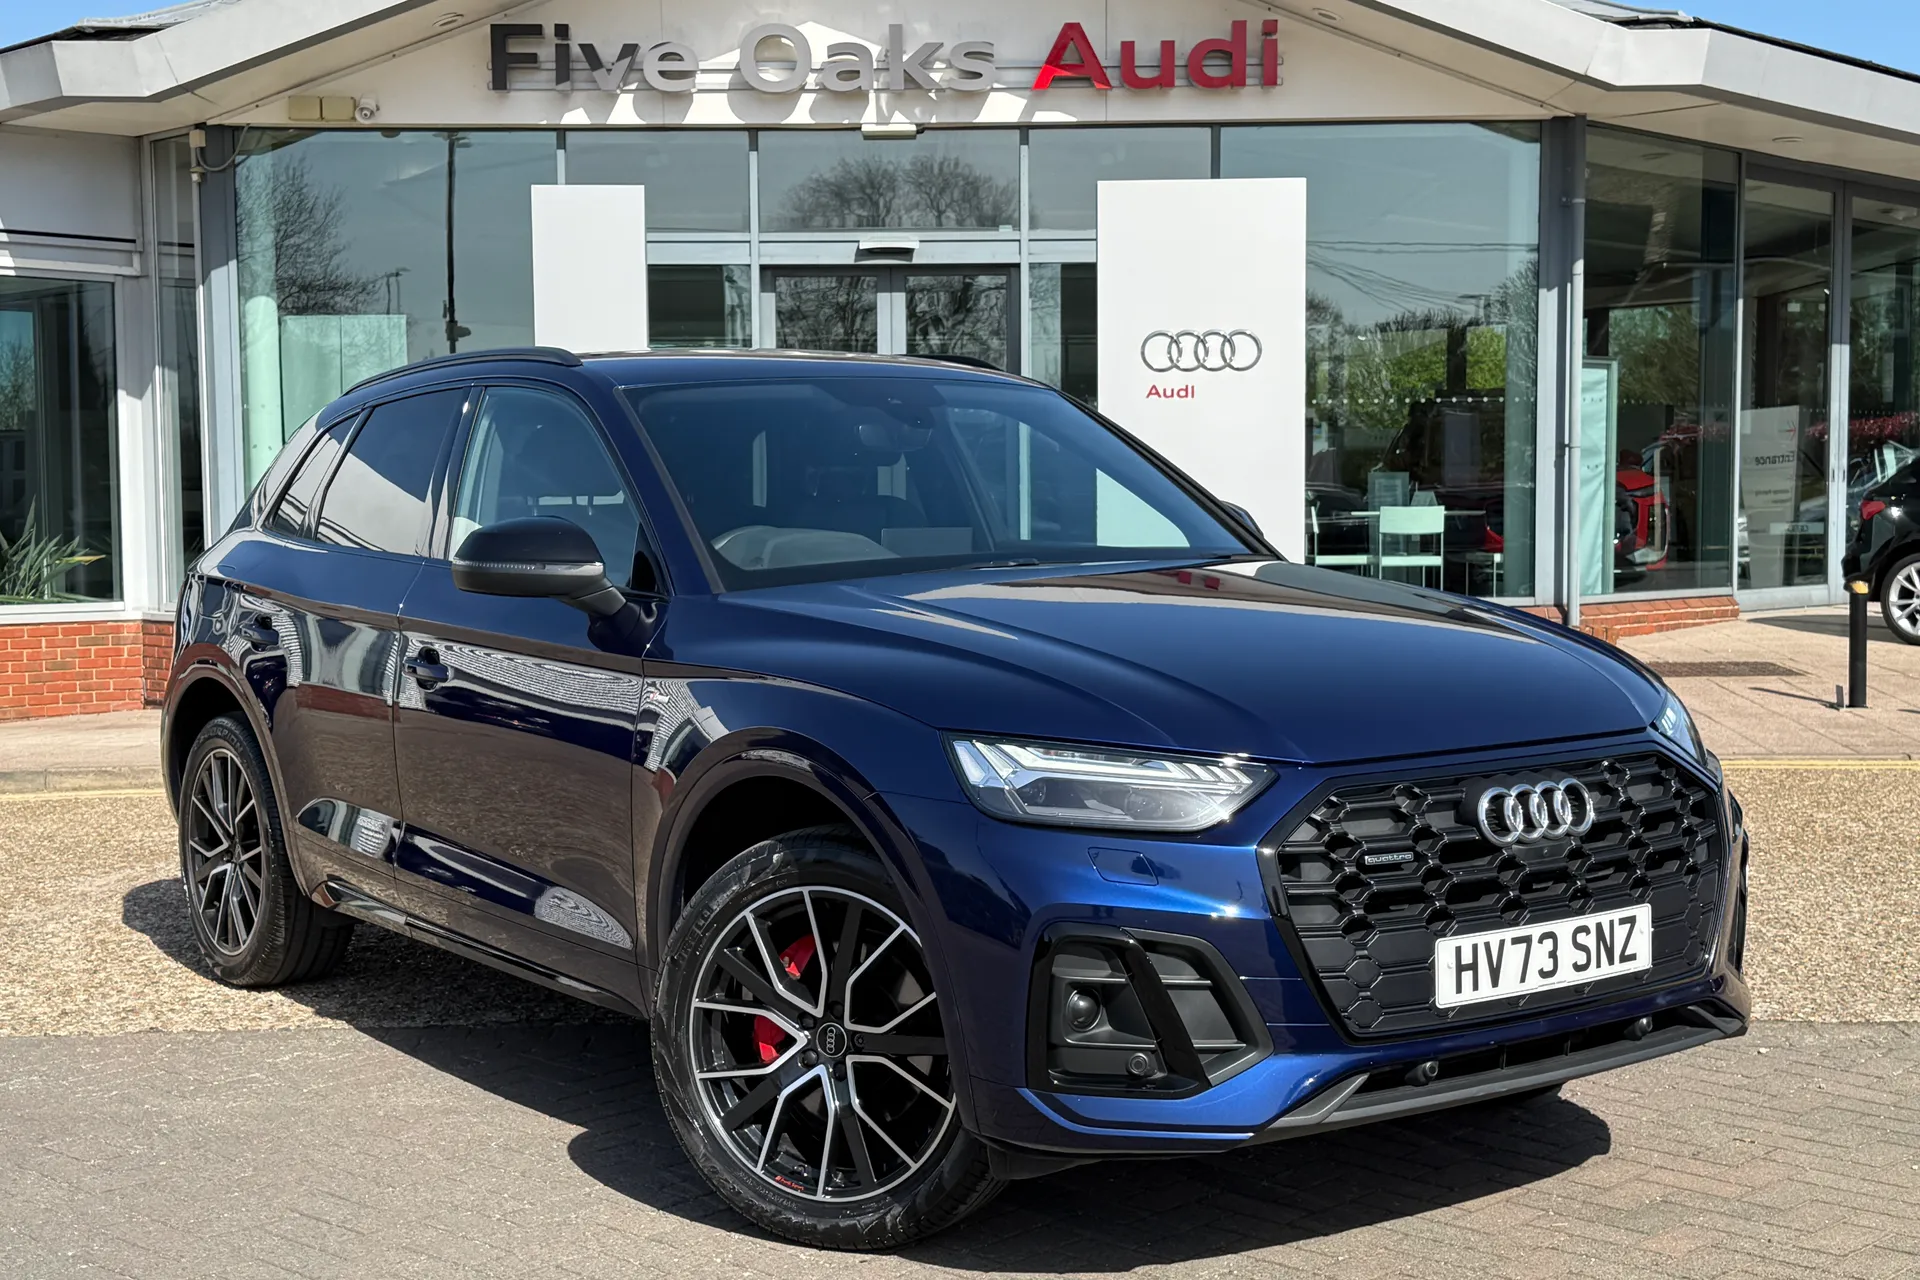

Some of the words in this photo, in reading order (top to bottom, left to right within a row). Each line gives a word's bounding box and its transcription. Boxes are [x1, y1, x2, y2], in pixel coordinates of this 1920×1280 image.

[489, 22, 698, 92] Five
[739, 23, 996, 93] Oaks
[1032, 19, 1279, 90] Audi
[1146, 384, 1195, 399] Audi
[1367, 854, 1412, 864] quattro
[1454, 930, 1559, 995] HV73
[1571, 914, 1637, 973] SNZ
